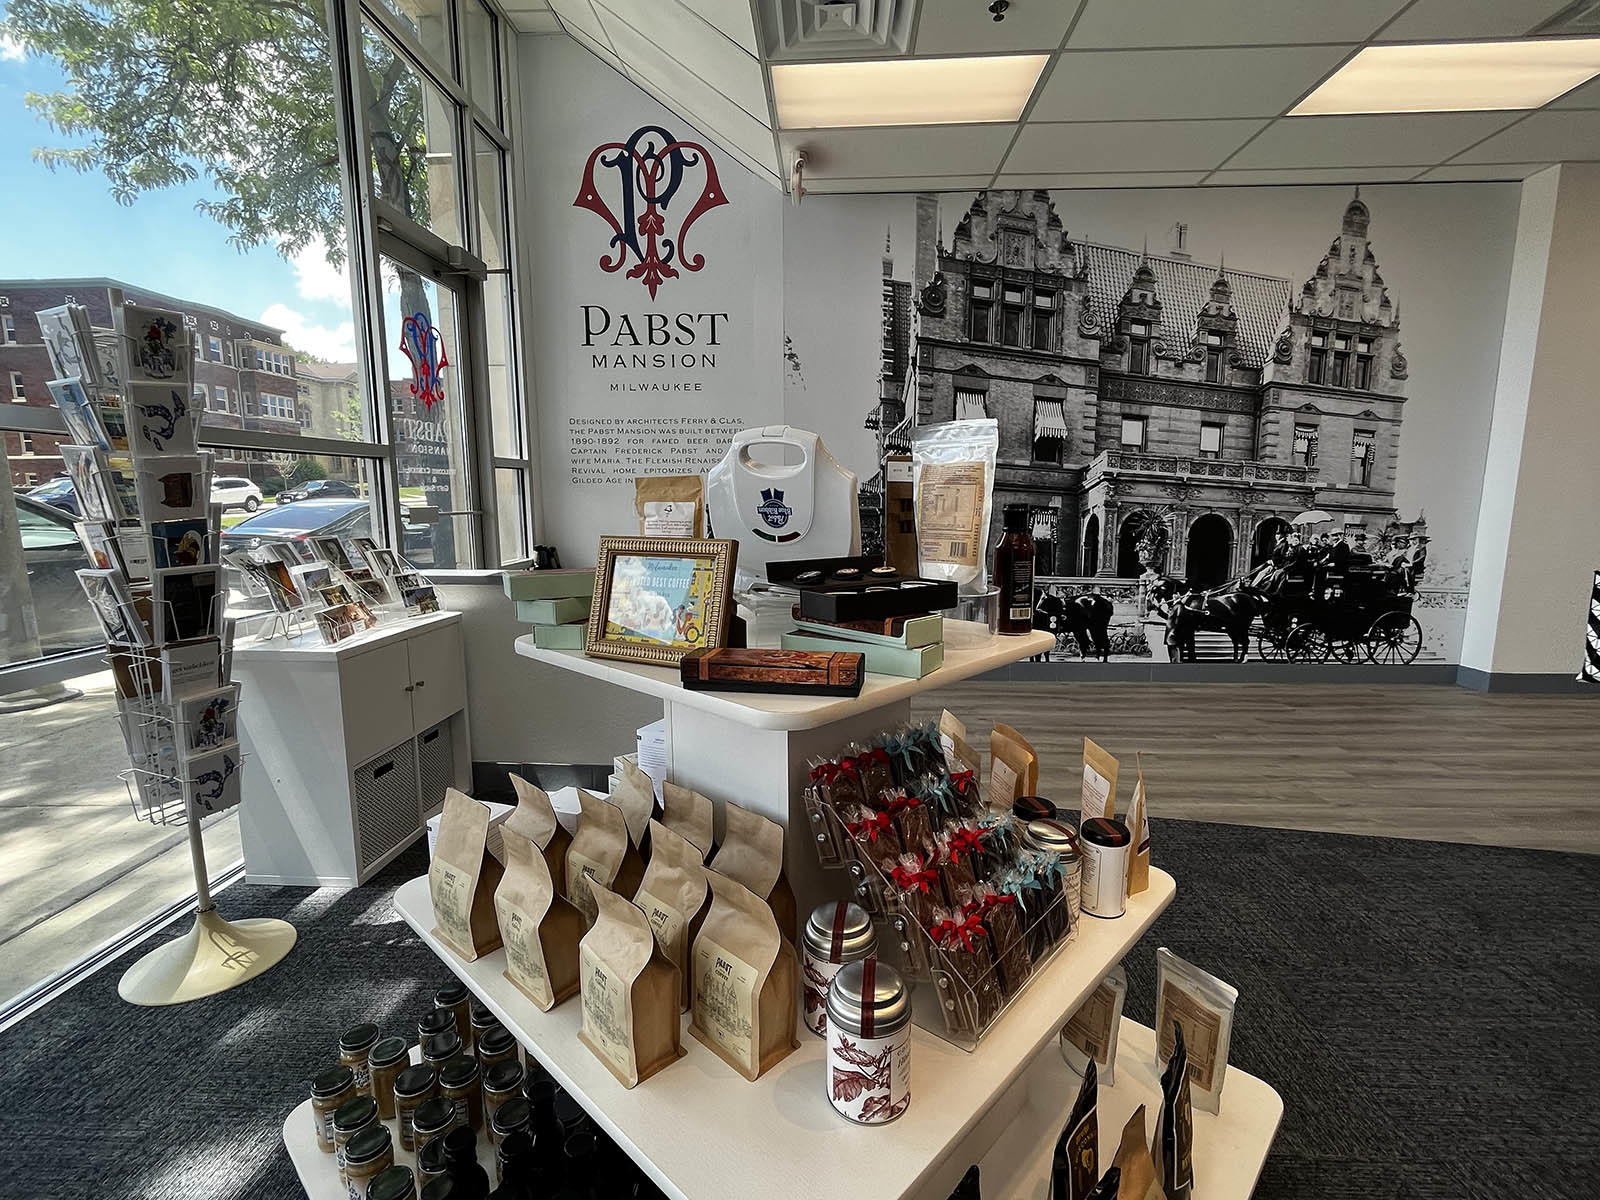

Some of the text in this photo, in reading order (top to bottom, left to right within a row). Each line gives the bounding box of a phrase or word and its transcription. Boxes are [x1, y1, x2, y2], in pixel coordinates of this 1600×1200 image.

[579, 305, 729, 346] PABST
[592, 353, 715, 368] MANSION
[610, 383, 702, 392] MILWAUKEE
[569, 417, 613, 425] DESIGNED
[681, 417, 708, 425] FERRY
[710, 417, 717, 425] &
[571, 437, 620, 445] 1890-1892
[570, 447, 607, 455] CAPTAIN
[615, 447, 663, 455] FREDERICK
[671, 447, 698, 455] PABST
[625, 457, 643, 465] THE
[645, 457, 683, 465] FLEMISH
[571, 467, 606, 475] REVIVAL
[572, 477, 603, 485] GILDED
[605, 477, 622, 485] AGE
